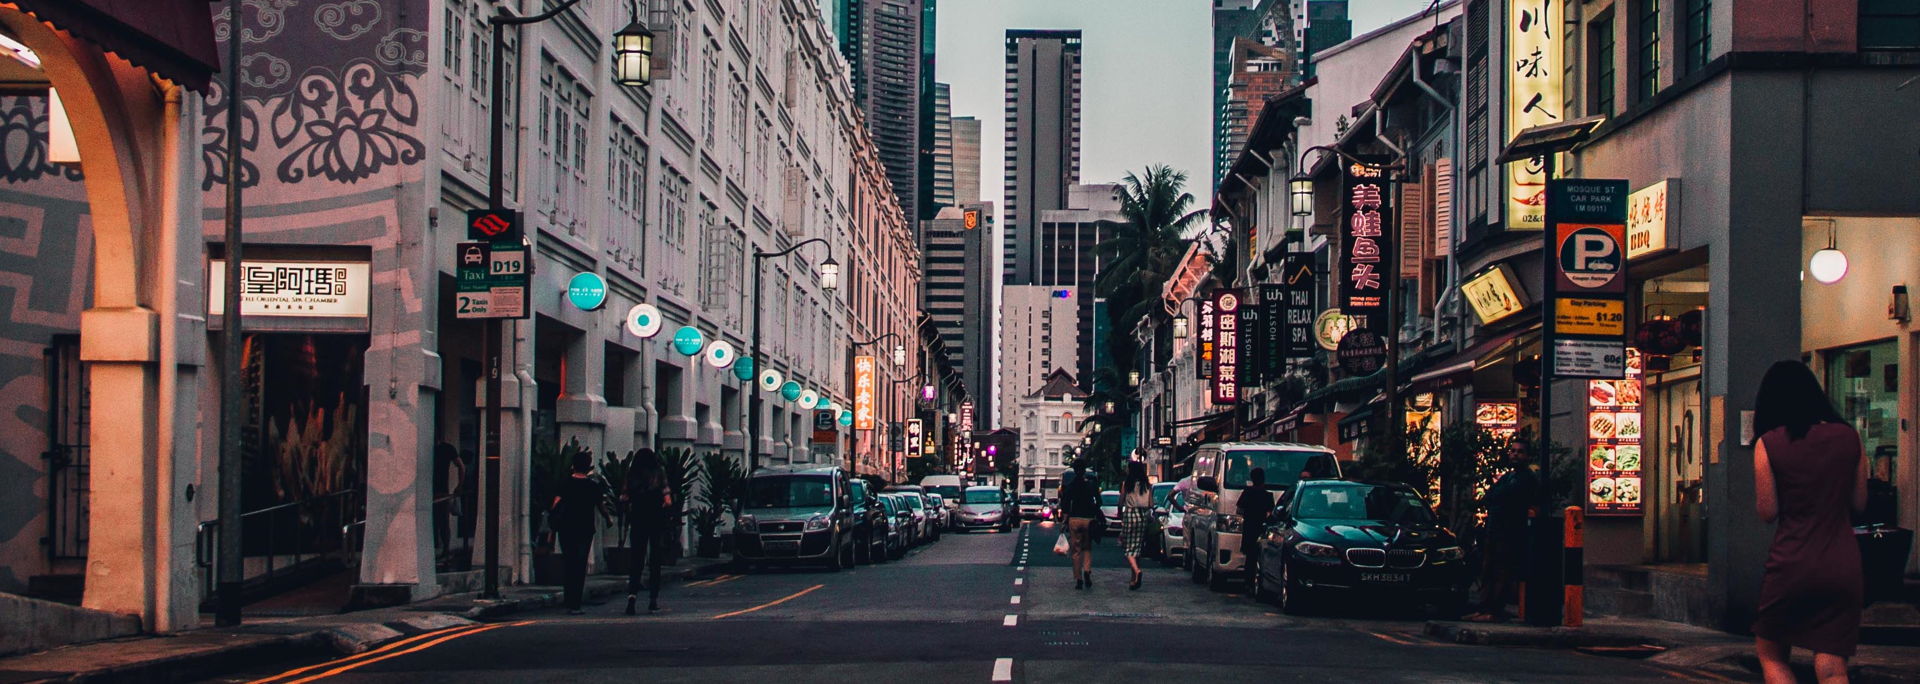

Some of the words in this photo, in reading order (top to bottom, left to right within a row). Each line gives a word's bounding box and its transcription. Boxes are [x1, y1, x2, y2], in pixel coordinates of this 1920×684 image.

[1567, 185, 1601, 193] MOSQUE
[1570, 194, 1587, 202] CAR
[1590, 194, 1612, 202] PARK
[1630, 229, 1650, 251] BBQ
[1574, 233, 1615, 270] P
[493, 260, 521, 273] D19
[463, 270, 485, 281] Taxi
[458, 296, 471, 314] 2
[1290, 291, 1309, 305] THAI
[1287, 309, 1312, 324] RELAX
[1596, 312, 1622, 322] $1.20
[1292, 327, 1308, 343] SPA
